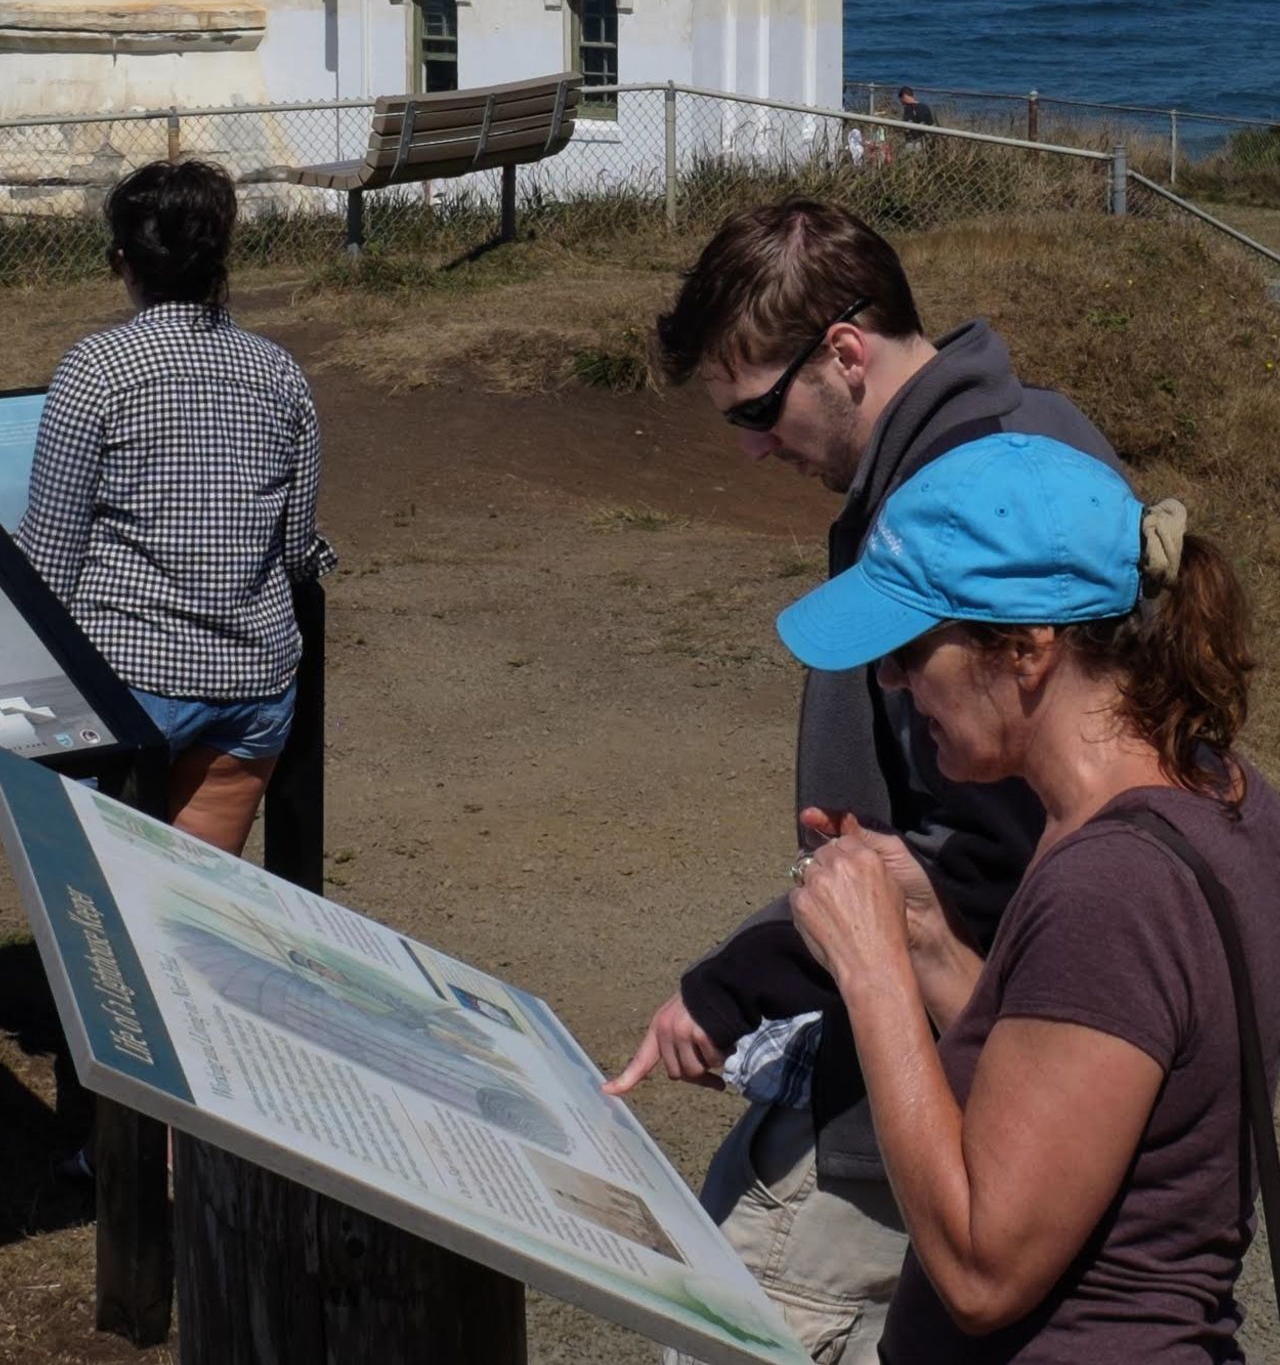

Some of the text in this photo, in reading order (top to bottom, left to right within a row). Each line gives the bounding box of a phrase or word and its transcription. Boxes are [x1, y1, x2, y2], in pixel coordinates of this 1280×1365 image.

[66, 884, 154, 1065] Life of a Lighthouse Keeper
